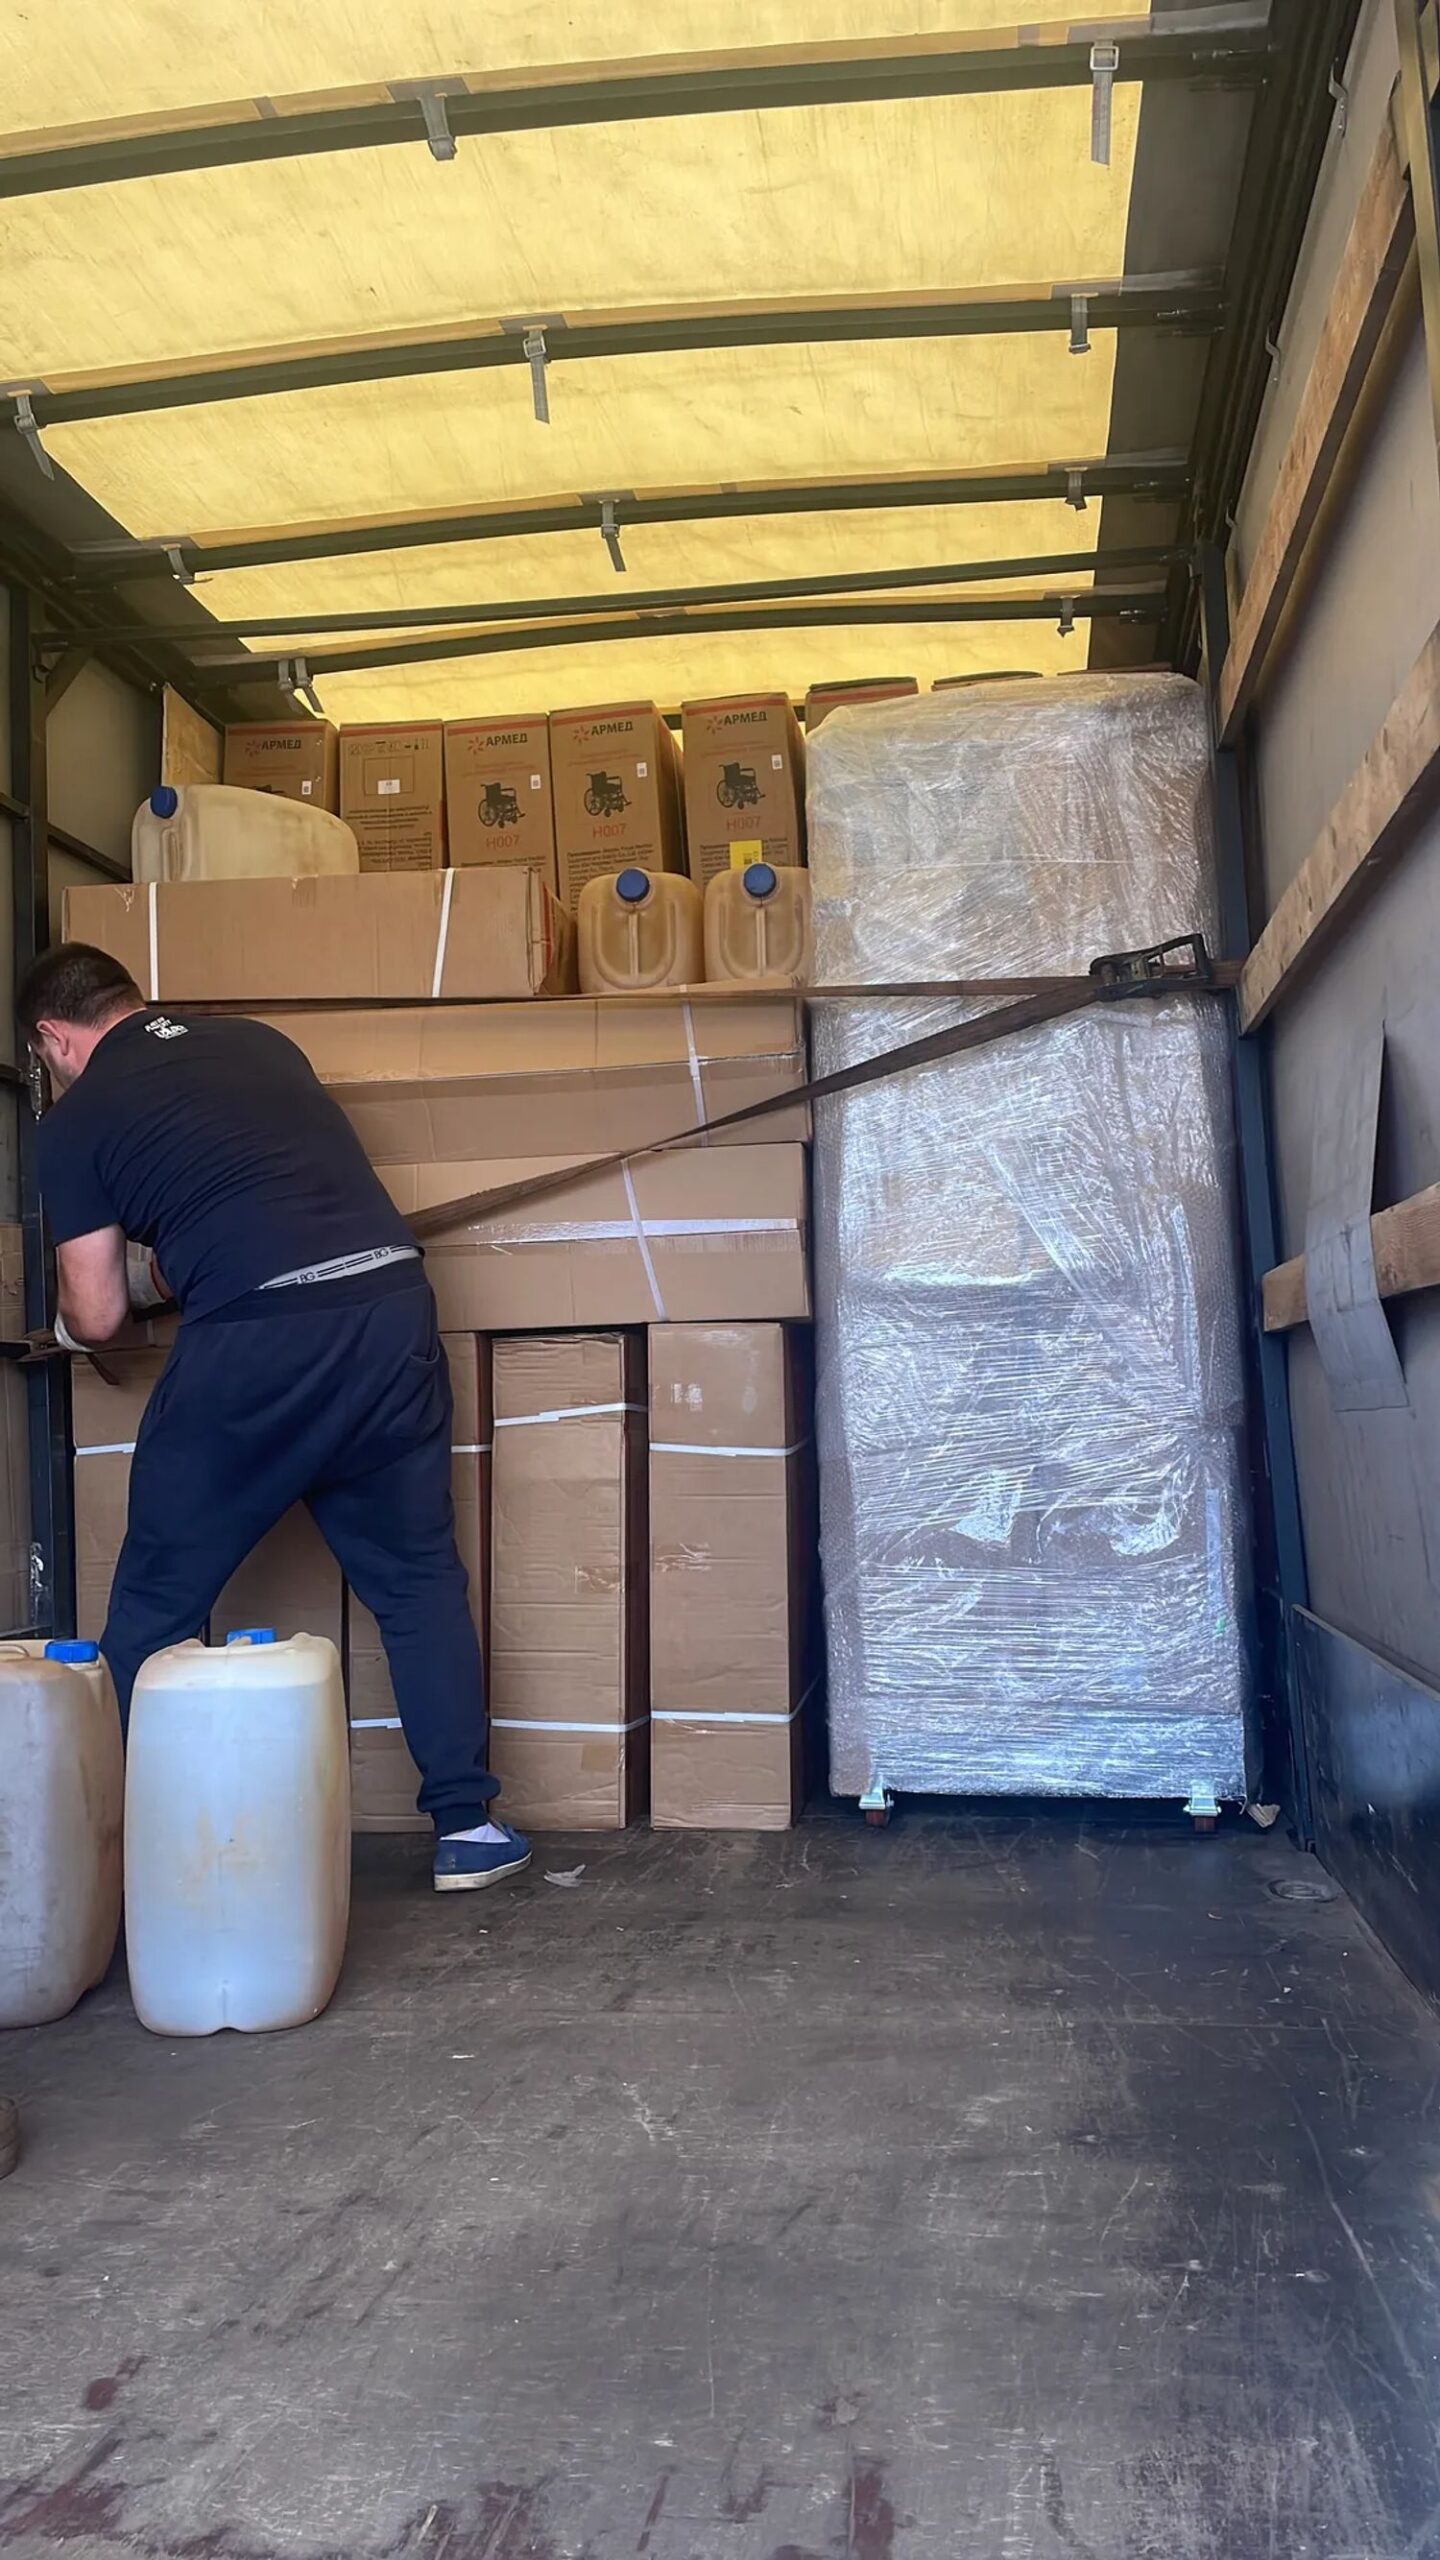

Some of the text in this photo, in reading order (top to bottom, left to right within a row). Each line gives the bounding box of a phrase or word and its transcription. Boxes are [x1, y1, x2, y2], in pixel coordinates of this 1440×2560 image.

[723, 711, 767, 726] АРМЕД
[591, 721, 634, 736] АРМЕД
[261, 738, 302, 751] АРМЕД
[486, 732, 528, 746] АРМЕД
[592, 823, 627, 838] H007
[726, 815, 761, 832] H007
[486, 834, 520, 849] H007
[373, 1248, 389, 1260] BG
[299, 1271, 316, 1284] BG
